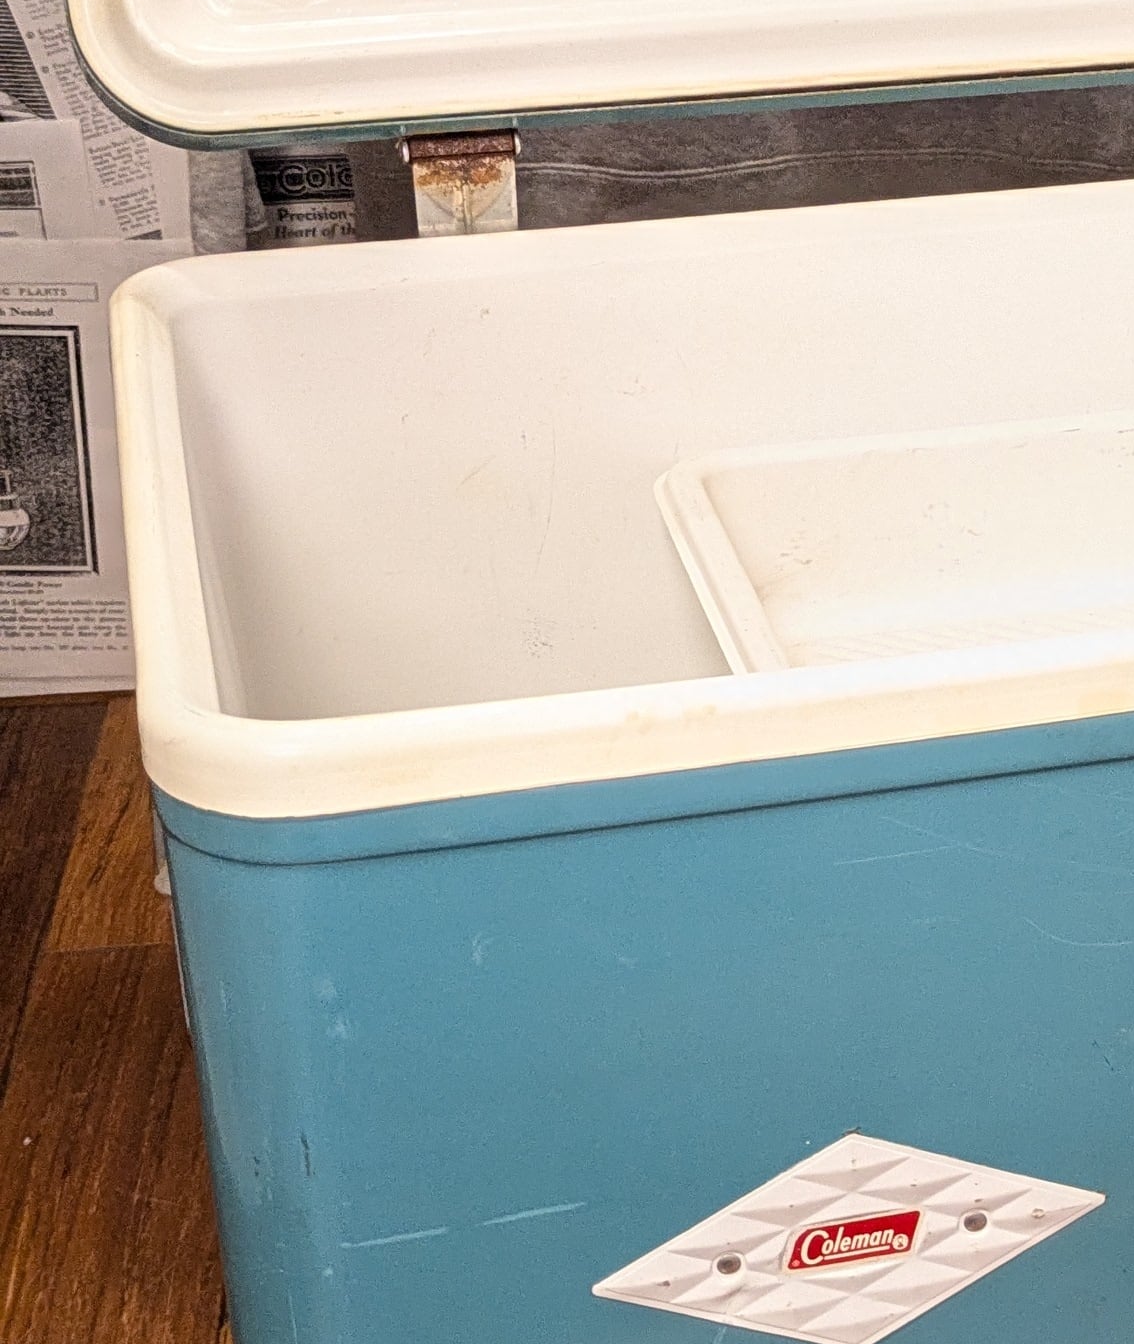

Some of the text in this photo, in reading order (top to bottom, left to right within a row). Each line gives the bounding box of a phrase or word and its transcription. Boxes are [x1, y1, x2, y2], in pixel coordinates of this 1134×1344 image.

[322, 223, 339, 238] of
[9, 307, 54, 316] Needed
[801, 1226, 895, 1265] Coleman
